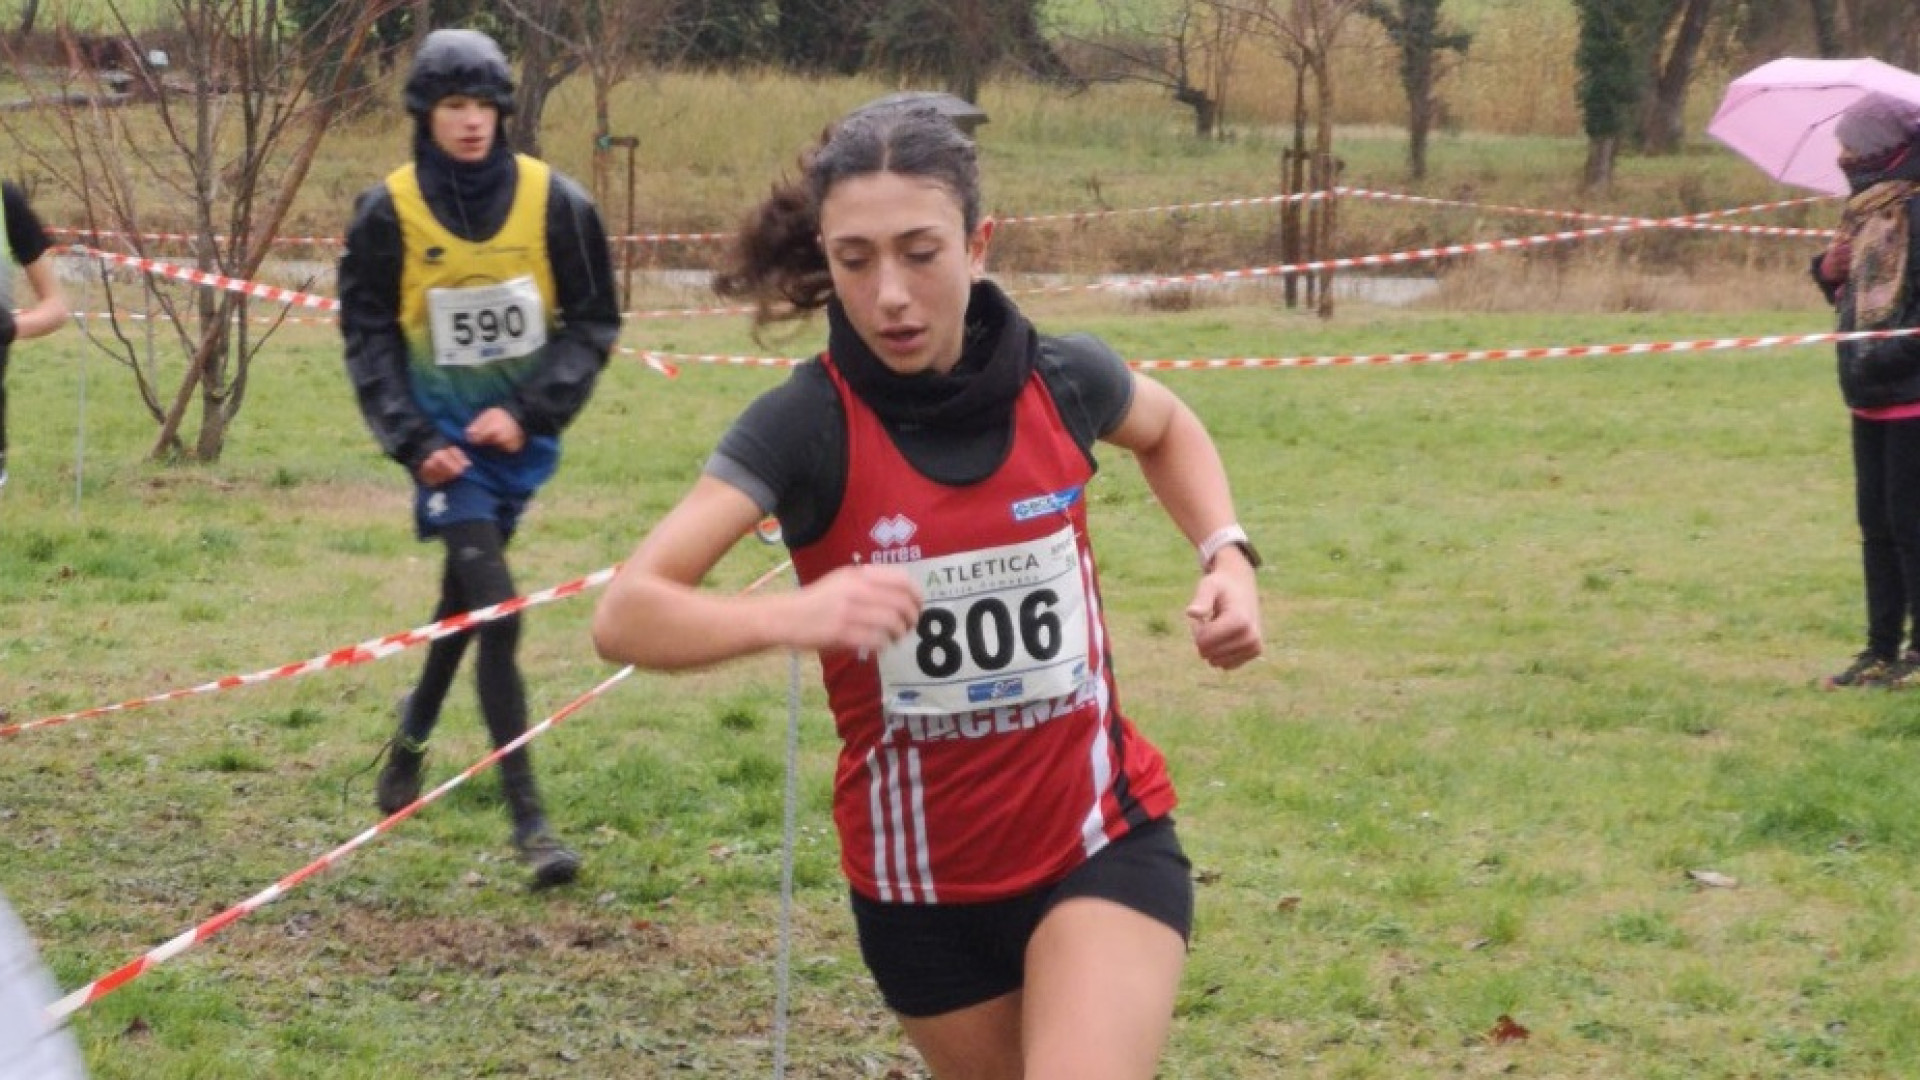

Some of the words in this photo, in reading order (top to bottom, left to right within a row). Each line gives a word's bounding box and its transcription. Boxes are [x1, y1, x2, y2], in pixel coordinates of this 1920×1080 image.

[454, 304, 525, 346] 590
[926, 552, 1040, 588] ATLETICA
[916, 588, 1062, 678] 806
